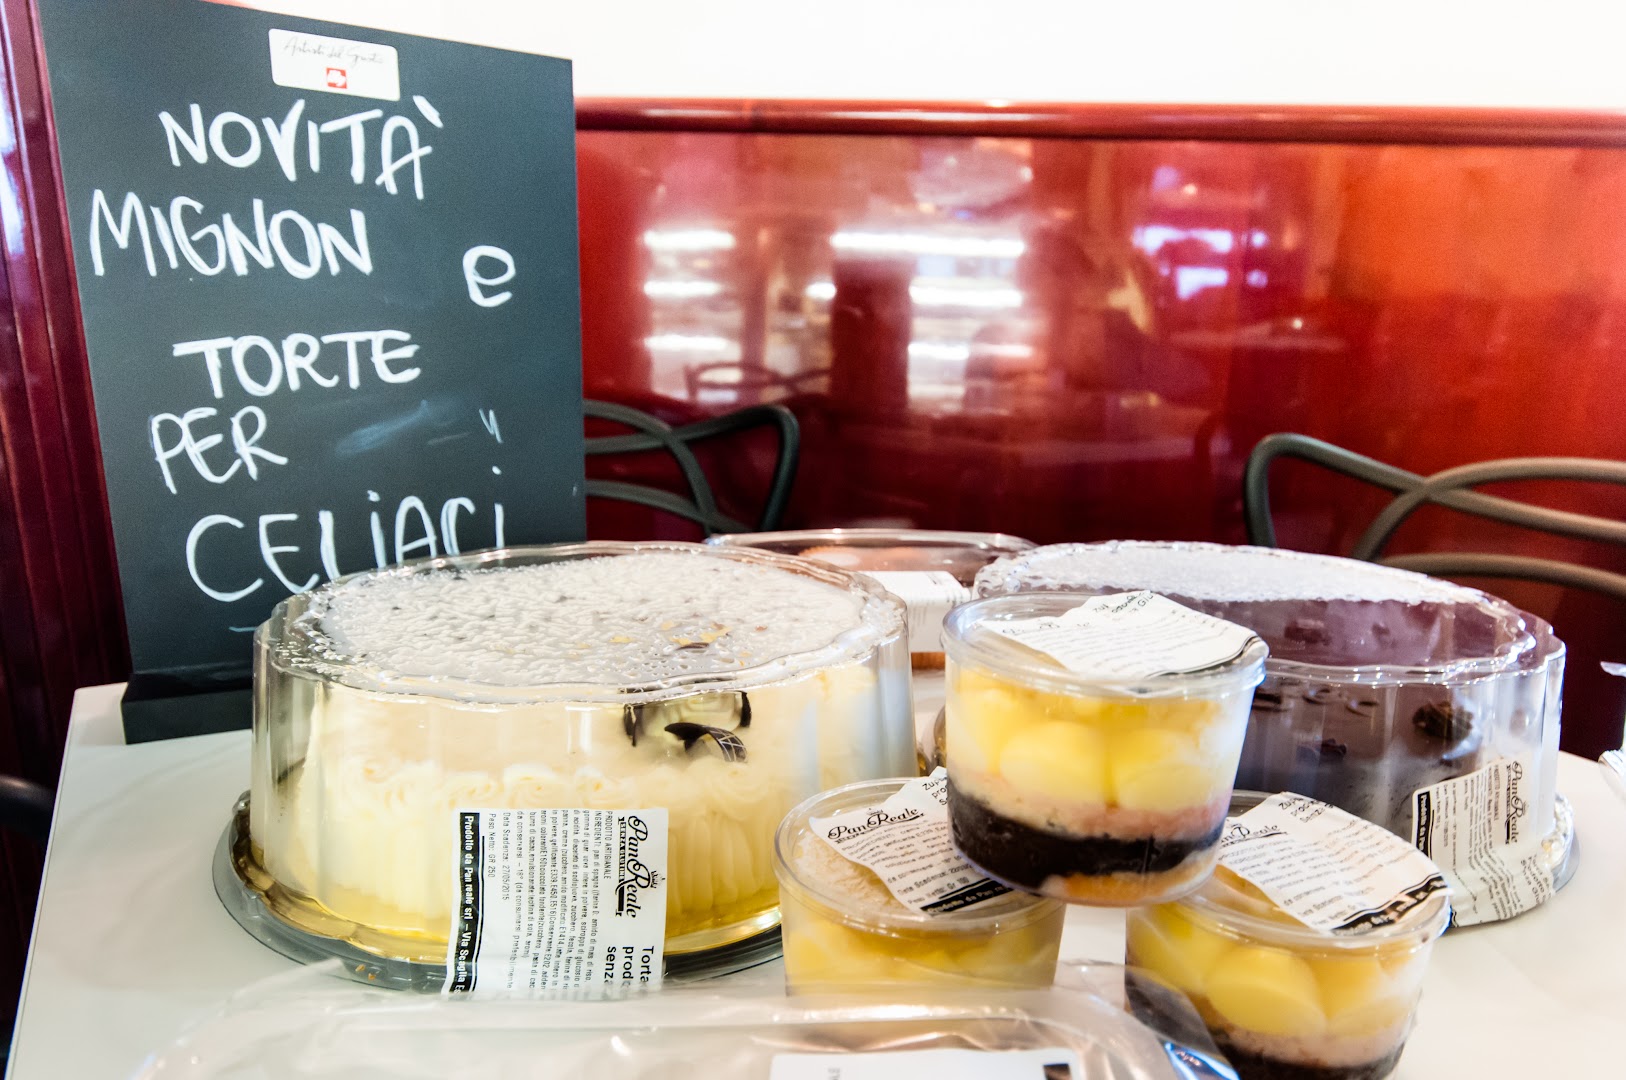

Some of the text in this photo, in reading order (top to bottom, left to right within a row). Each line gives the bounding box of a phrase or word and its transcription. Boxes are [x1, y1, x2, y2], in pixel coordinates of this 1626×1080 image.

[158, 94, 444, 200] NOVITÀ
[89, 188, 517, 308] MIGNON e
[172, 329, 421, 399] TORTE
[149, 404, 288, 494] PER
[488, 814, 496, 830] Peso
[503, 812, 511, 826] Data
[464, 816, 474, 851] Prodotto
[502, 829, 511, 862] Scadenza:
[604, 811, 613, 879] PRODOTTO ARTIGIANALE
[464, 853, 474, 864] da
[488, 854, 496, 863] GR
[464, 867, 473, 882] Pan
[488, 866, 496, 878] 250
[465, 884, 474, 904] reale
[464, 908, 473, 919] srl
[590, 919, 599, 936] amido
[457, 950, 470, 982] Scaglia
